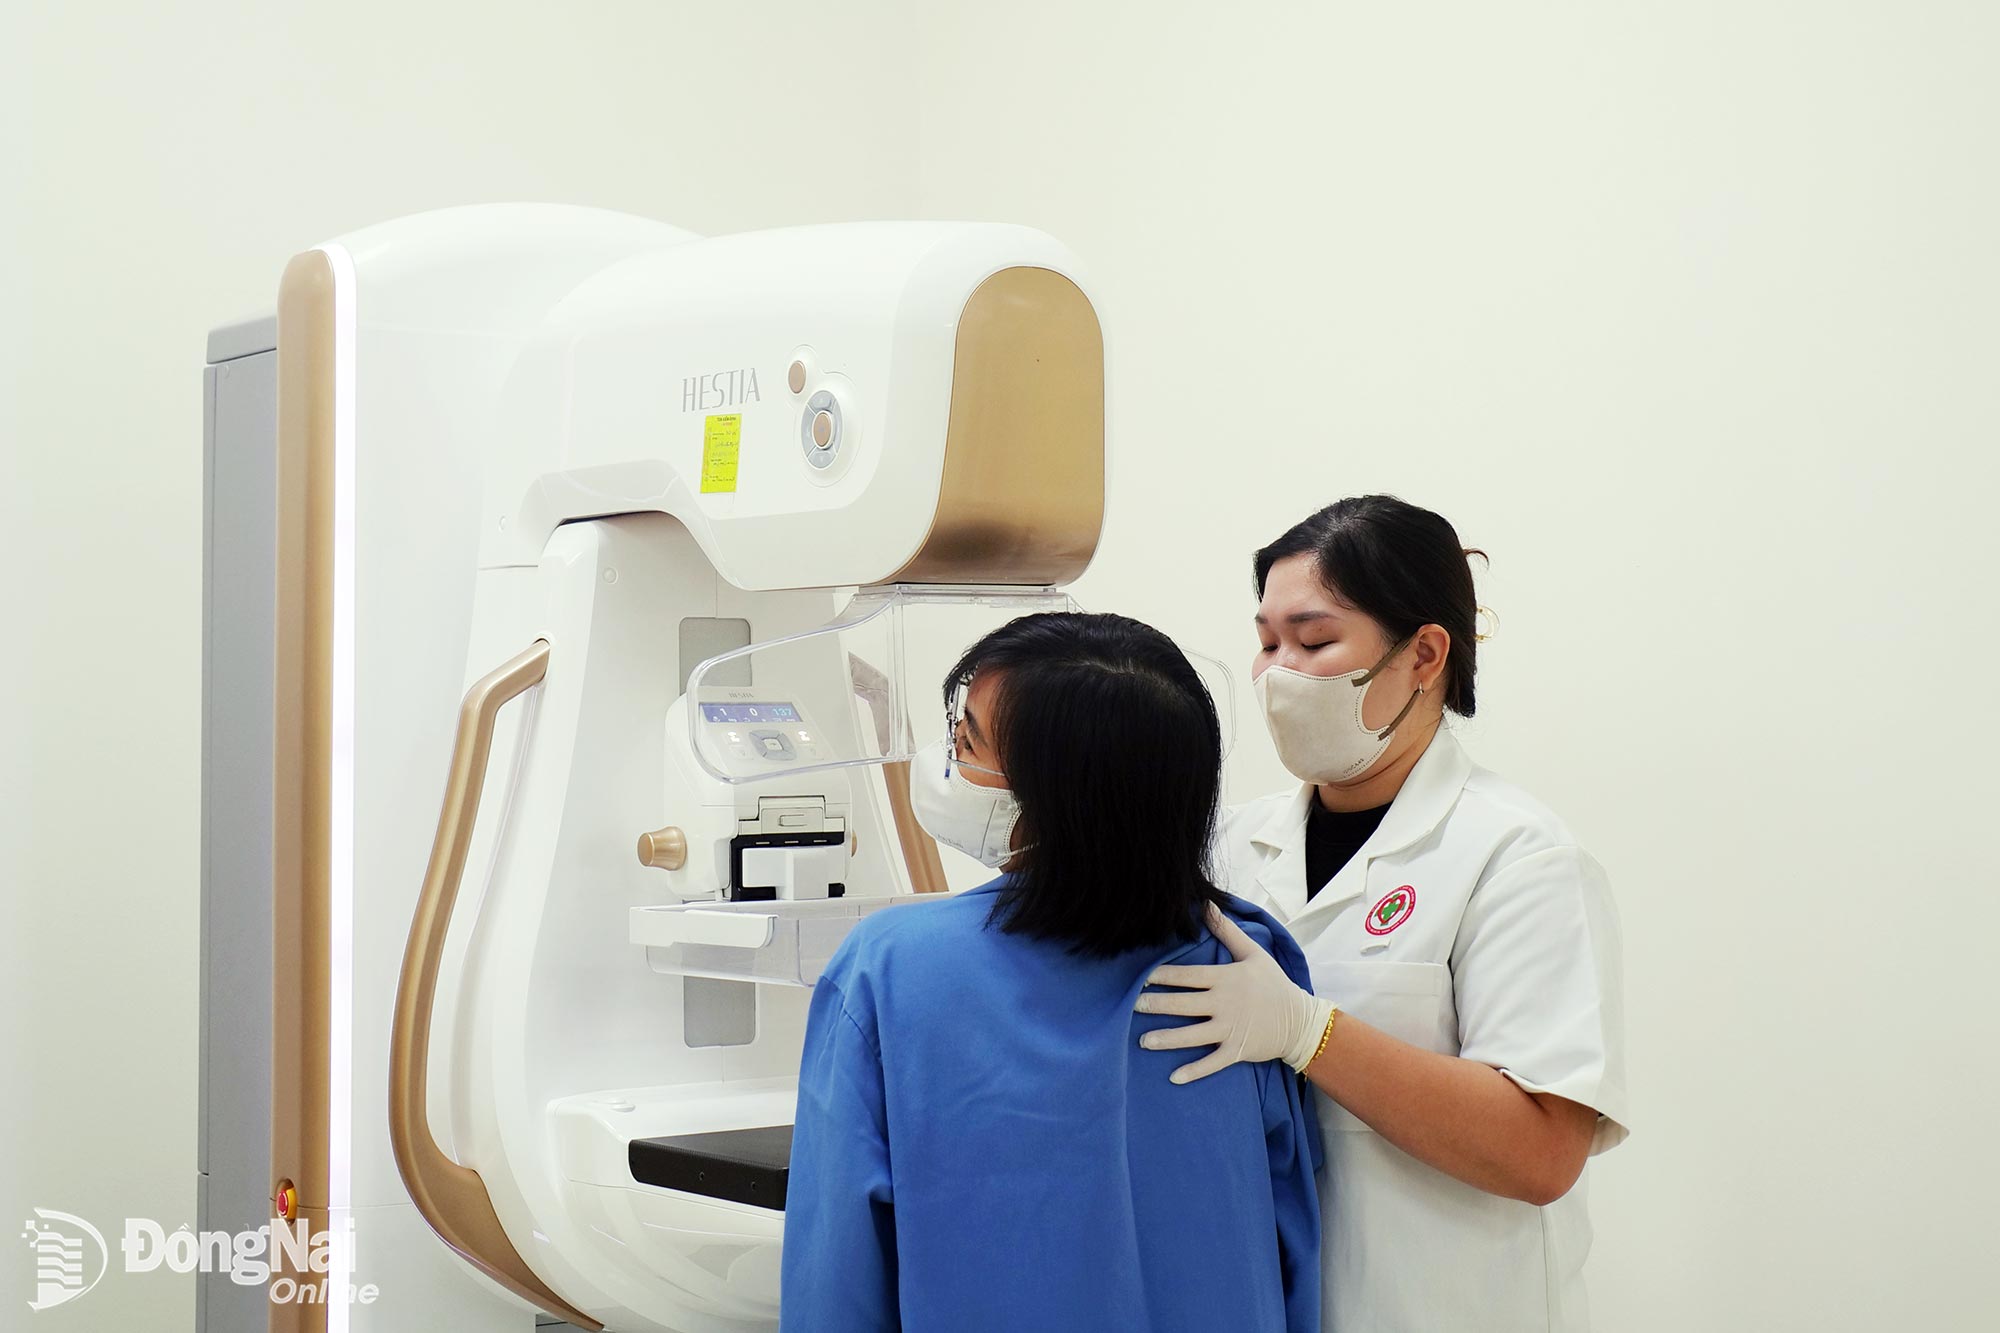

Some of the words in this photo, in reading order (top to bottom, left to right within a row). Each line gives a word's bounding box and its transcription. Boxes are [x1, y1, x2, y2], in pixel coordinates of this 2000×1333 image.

[682, 368, 760, 412] HESTIA
[720, 708, 727, 716] 1
[749, 708, 758, 717] 0
